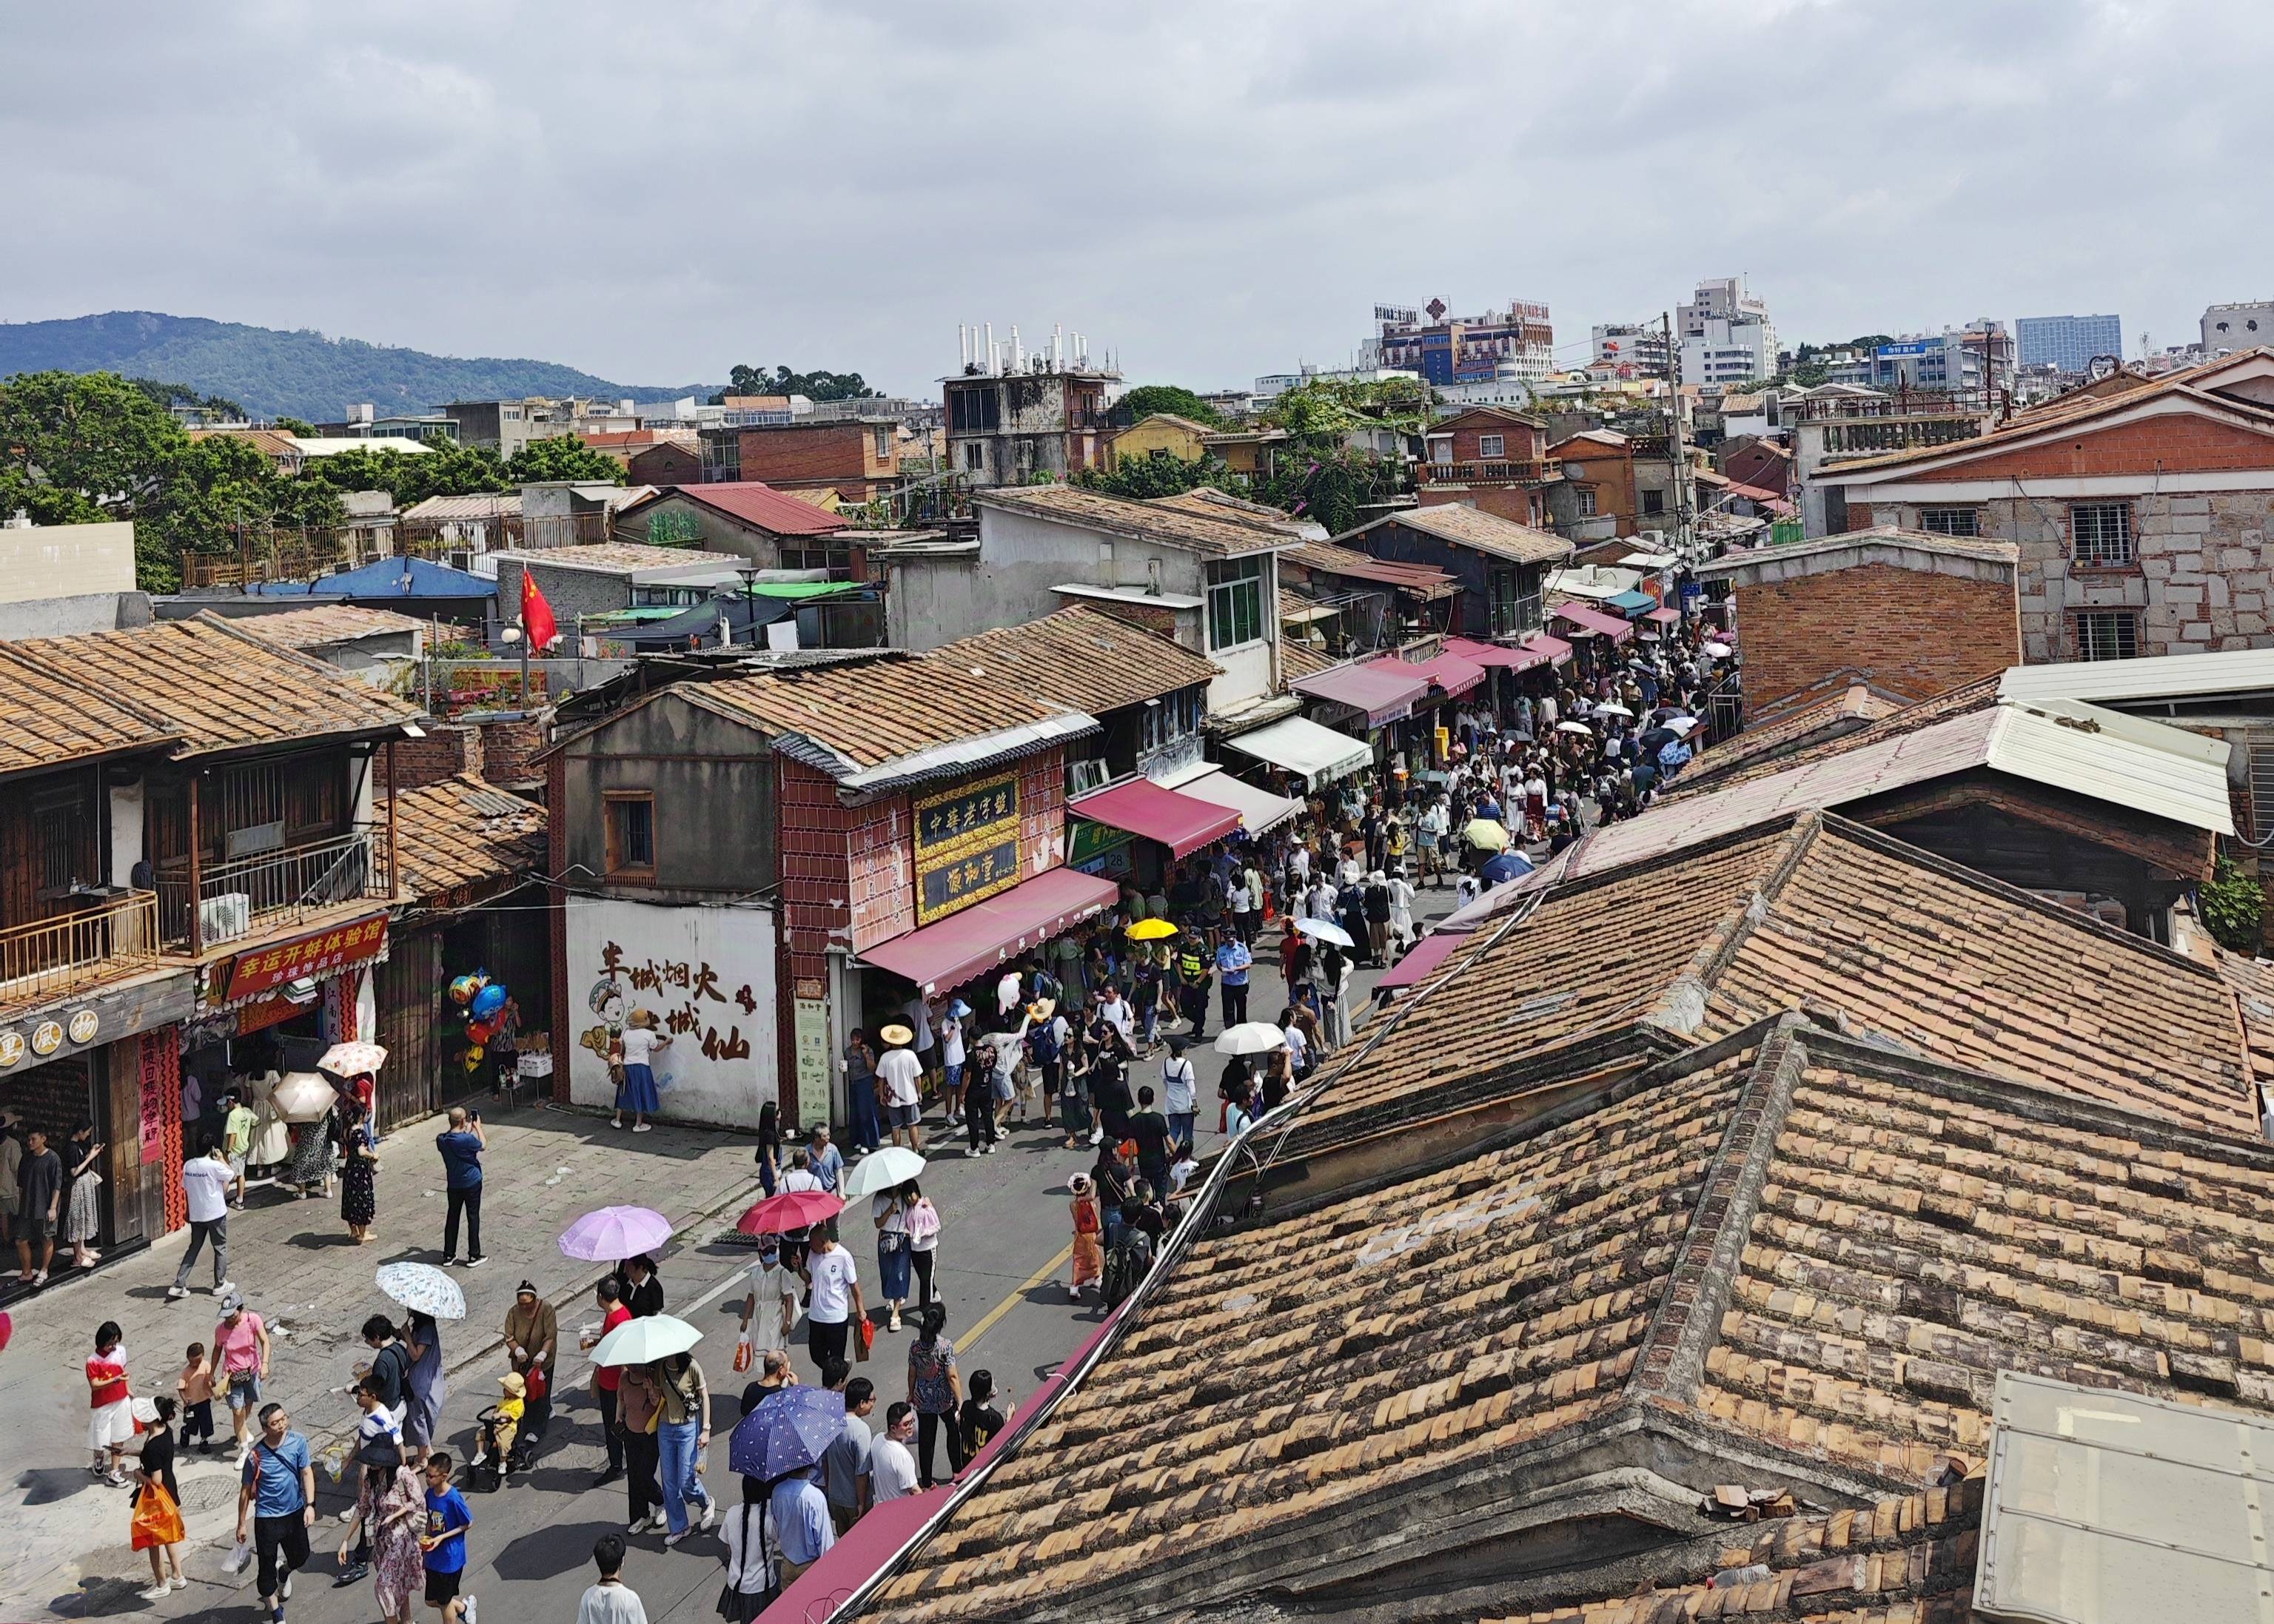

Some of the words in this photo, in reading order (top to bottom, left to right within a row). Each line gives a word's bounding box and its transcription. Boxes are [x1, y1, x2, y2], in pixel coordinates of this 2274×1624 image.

[930, 791, 1008, 838] 中華老字號
[1110, 854, 1123, 866] 28
[239, 920, 383, 979] 幸运开蚌体验馆
[271, 952, 344, 984] 珍珠饰品店
[597, 940, 728, 1003] 半城烟火
[831, 1264, 836, 1273] G
